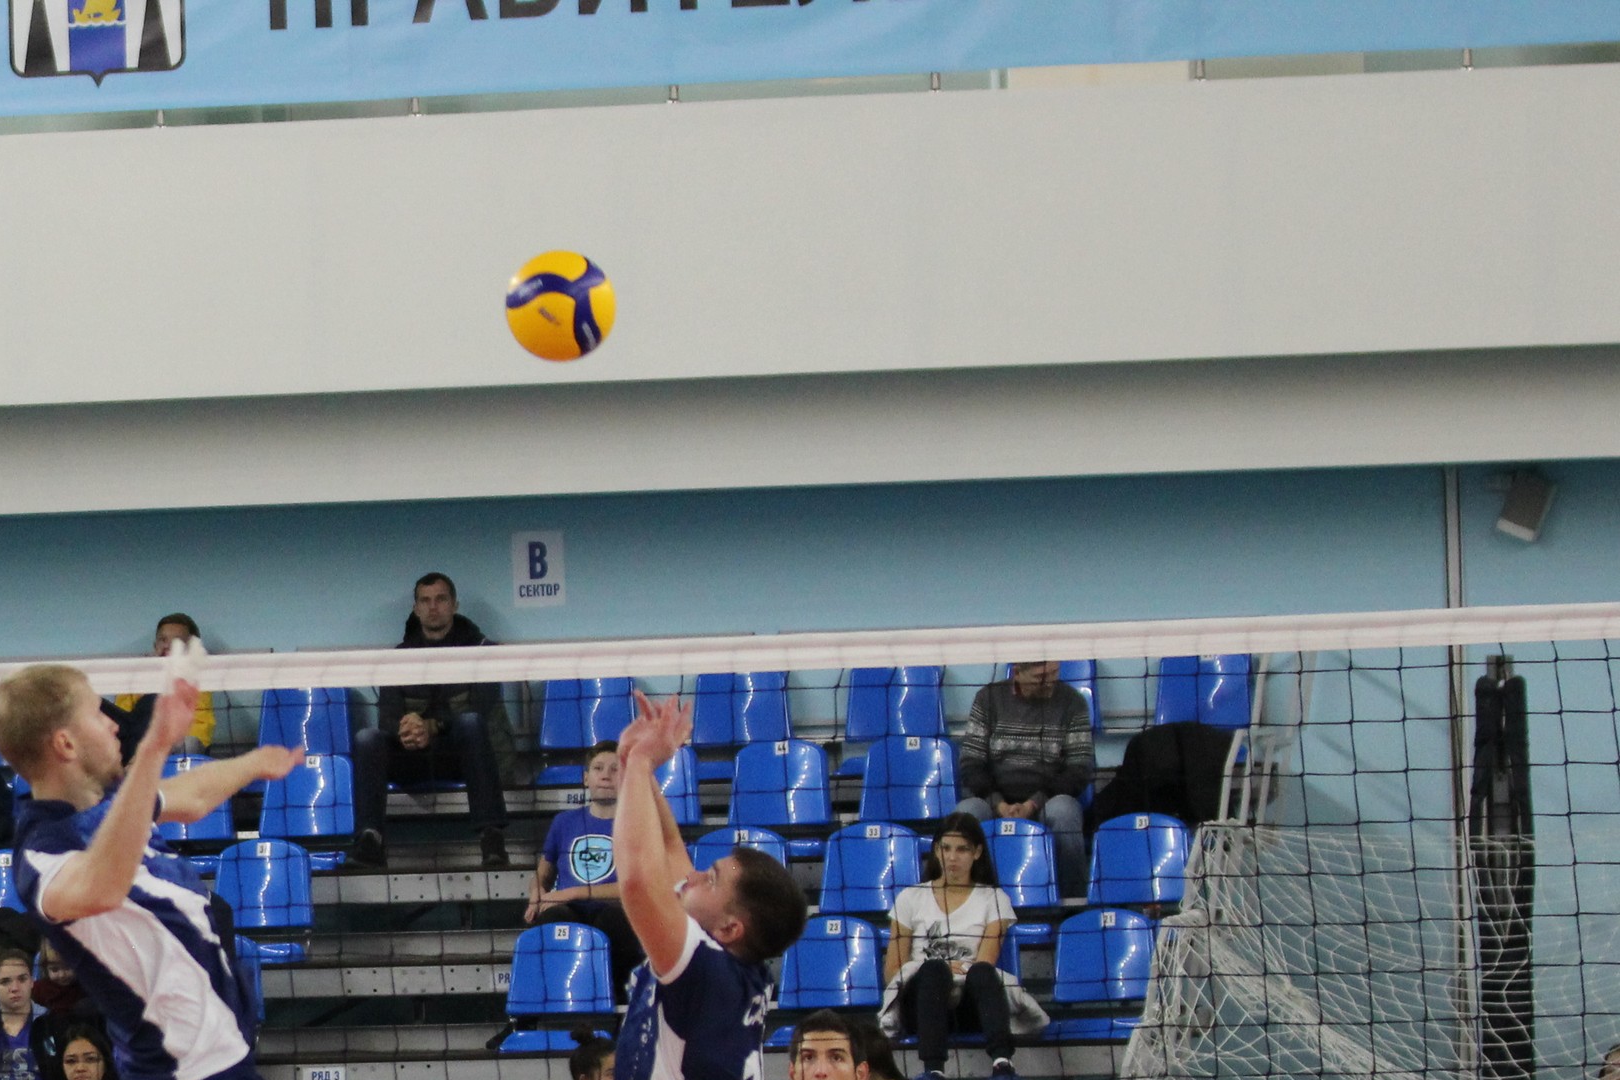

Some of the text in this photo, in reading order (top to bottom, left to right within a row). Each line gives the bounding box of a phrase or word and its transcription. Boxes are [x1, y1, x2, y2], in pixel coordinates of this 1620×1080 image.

[528, 541, 548, 579] В
[519, 583, 560, 598] СЕКТОР
[868, 828, 878, 837] 33
[1003, 824, 1013, 833] 32
[557, 927, 567, 937] 25
[829, 923, 839, 932] 23
[499, 972, 511, 984] РЯ
